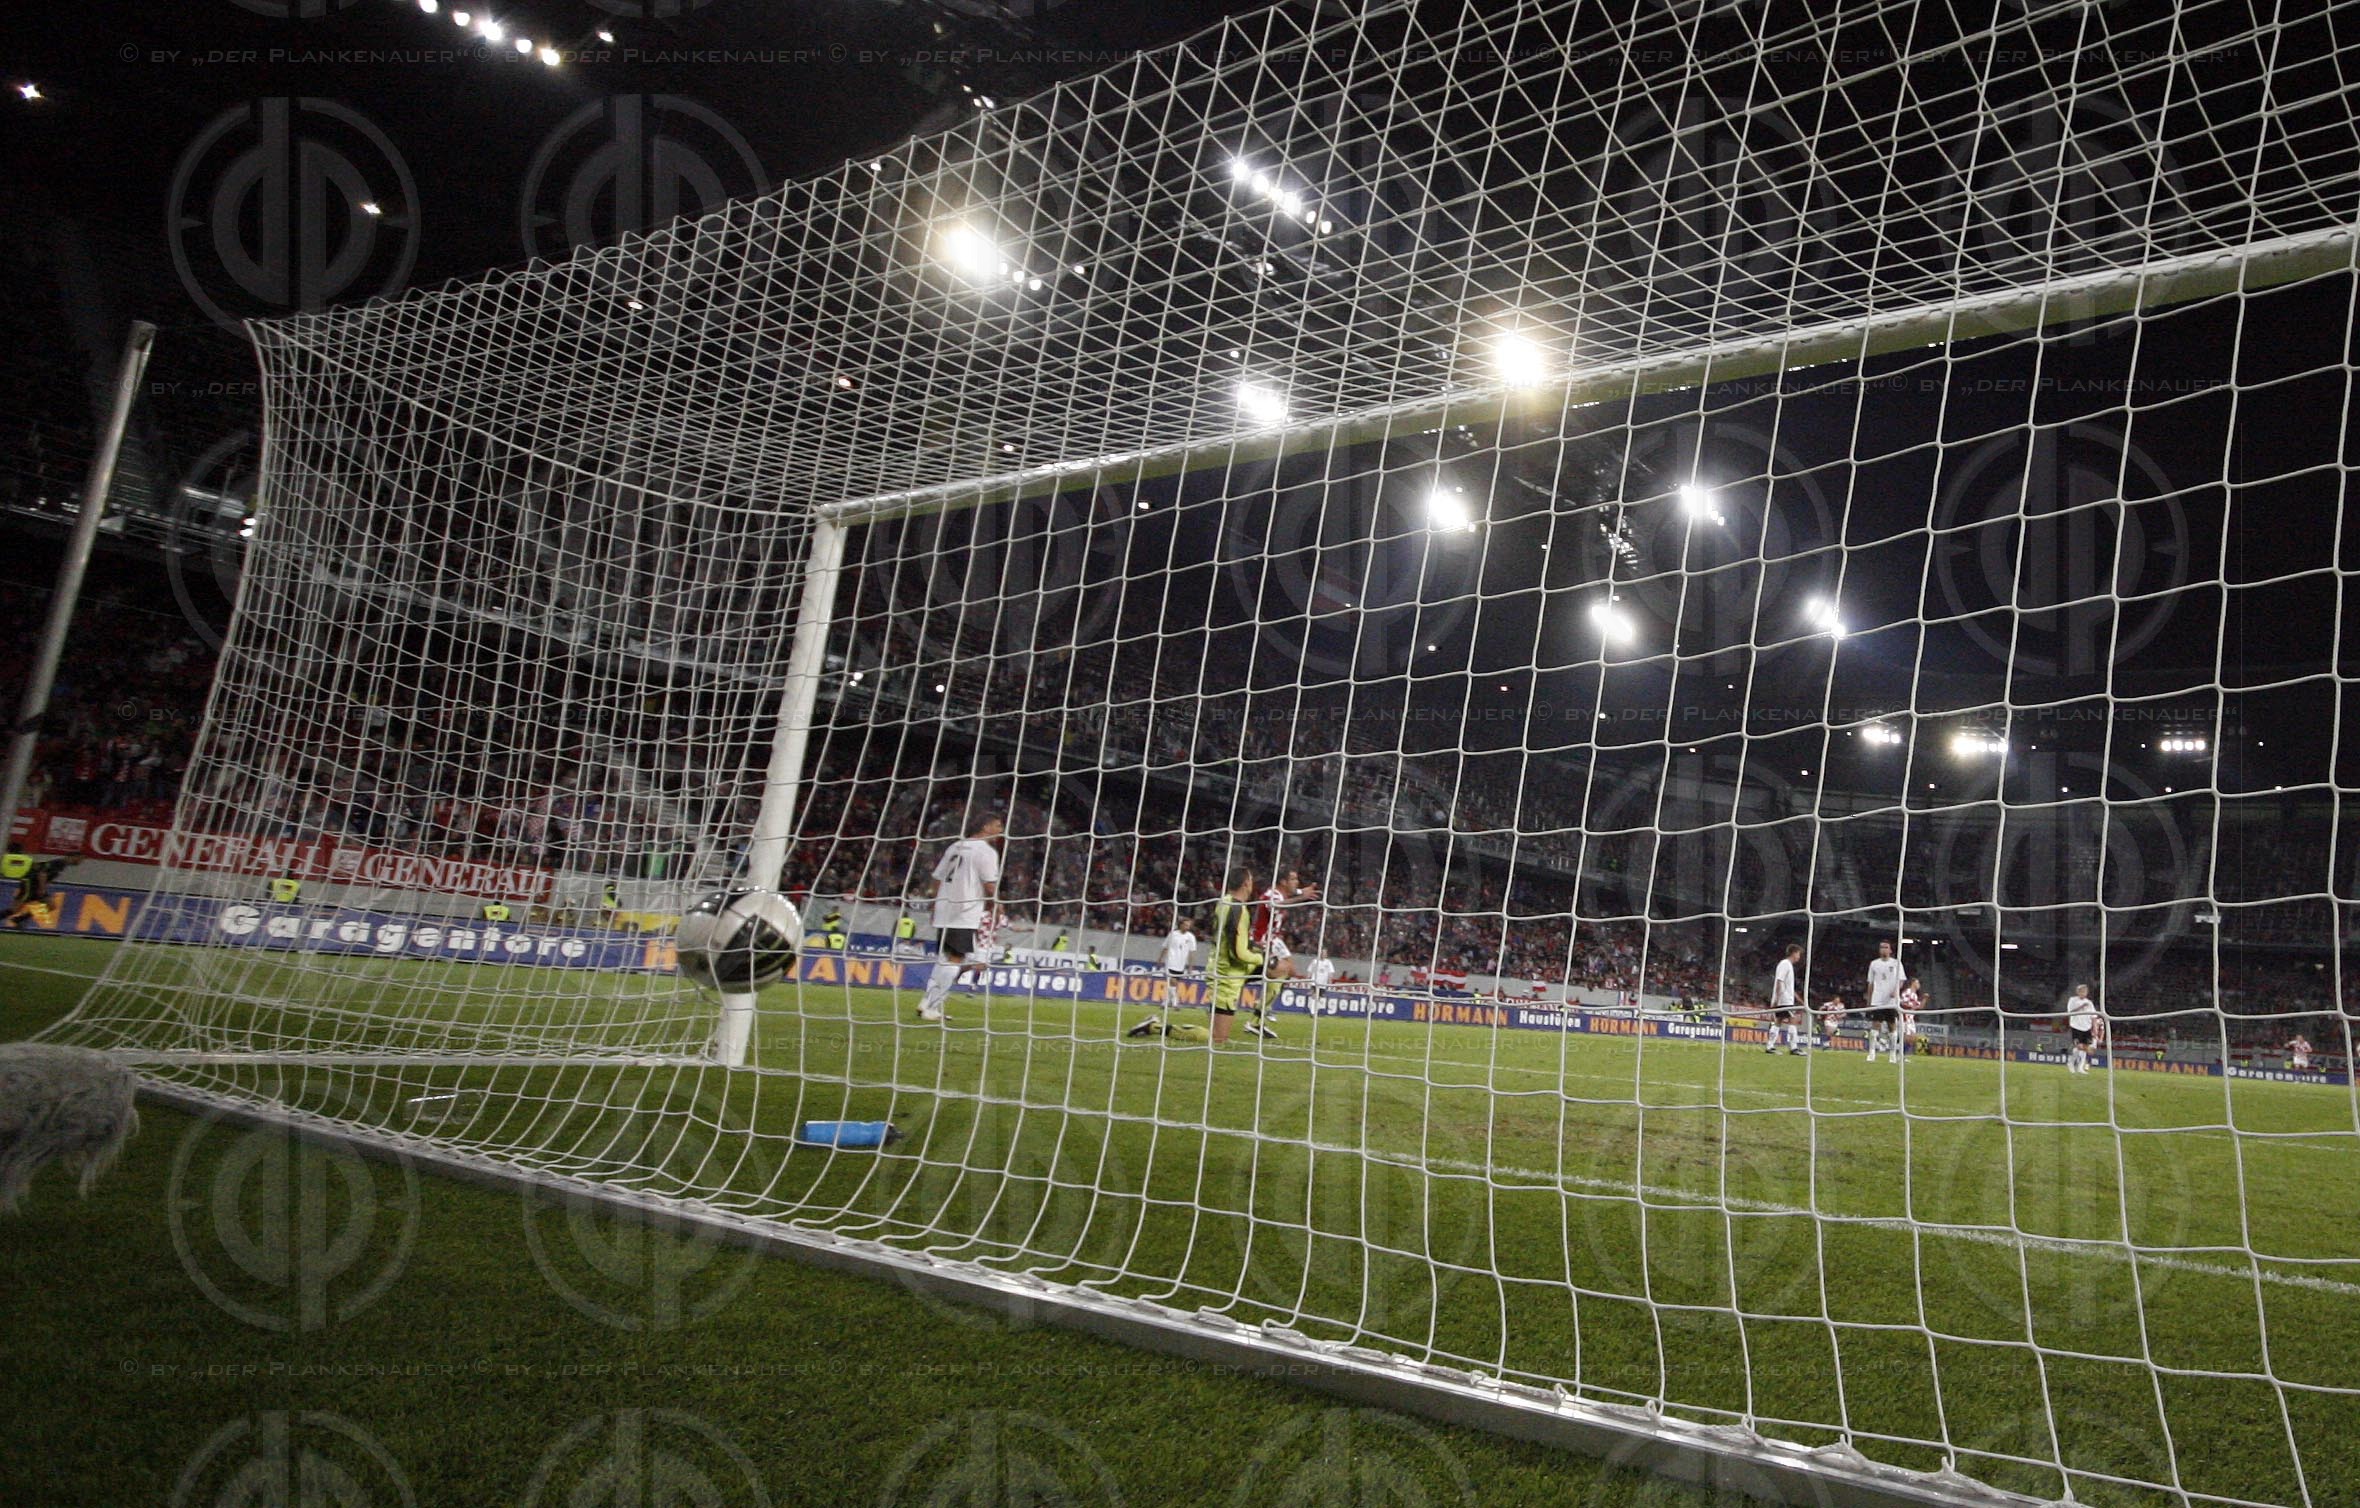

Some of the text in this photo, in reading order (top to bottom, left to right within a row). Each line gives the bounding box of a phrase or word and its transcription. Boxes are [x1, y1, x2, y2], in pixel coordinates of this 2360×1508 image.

[91, 822, 322, 879] GENERALI
[365, 853, 550, 895] GENERALI
[219, 905, 586, 958] Garagentore
